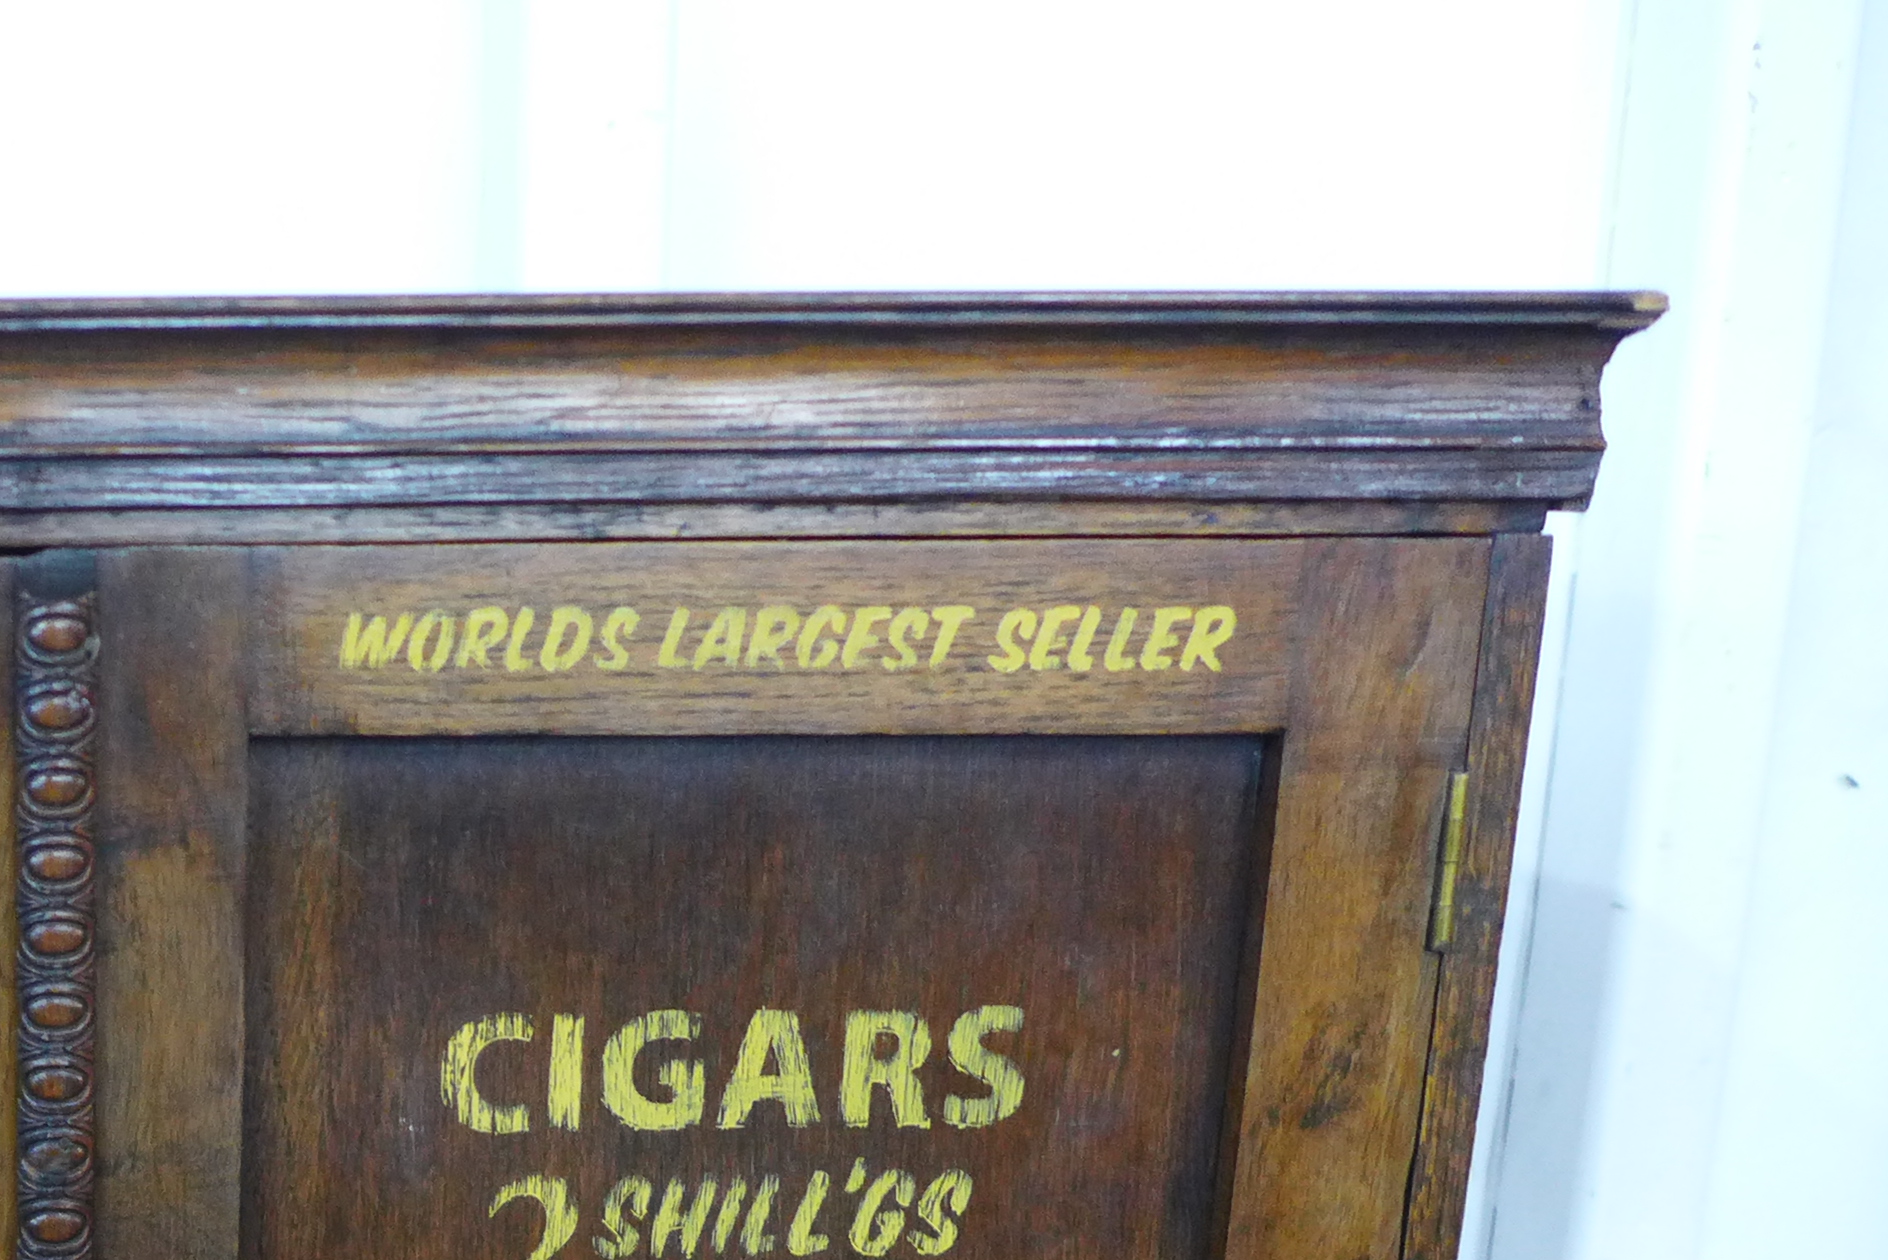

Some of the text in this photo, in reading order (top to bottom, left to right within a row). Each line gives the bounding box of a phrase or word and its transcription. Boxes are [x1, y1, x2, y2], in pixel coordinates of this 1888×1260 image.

[339, 605, 1236, 673] WORLDS LARGEST SELLER
[440, 1005, 1025, 1133] CIGARS
[592, 1157, 974, 1260] SHILL'GS
